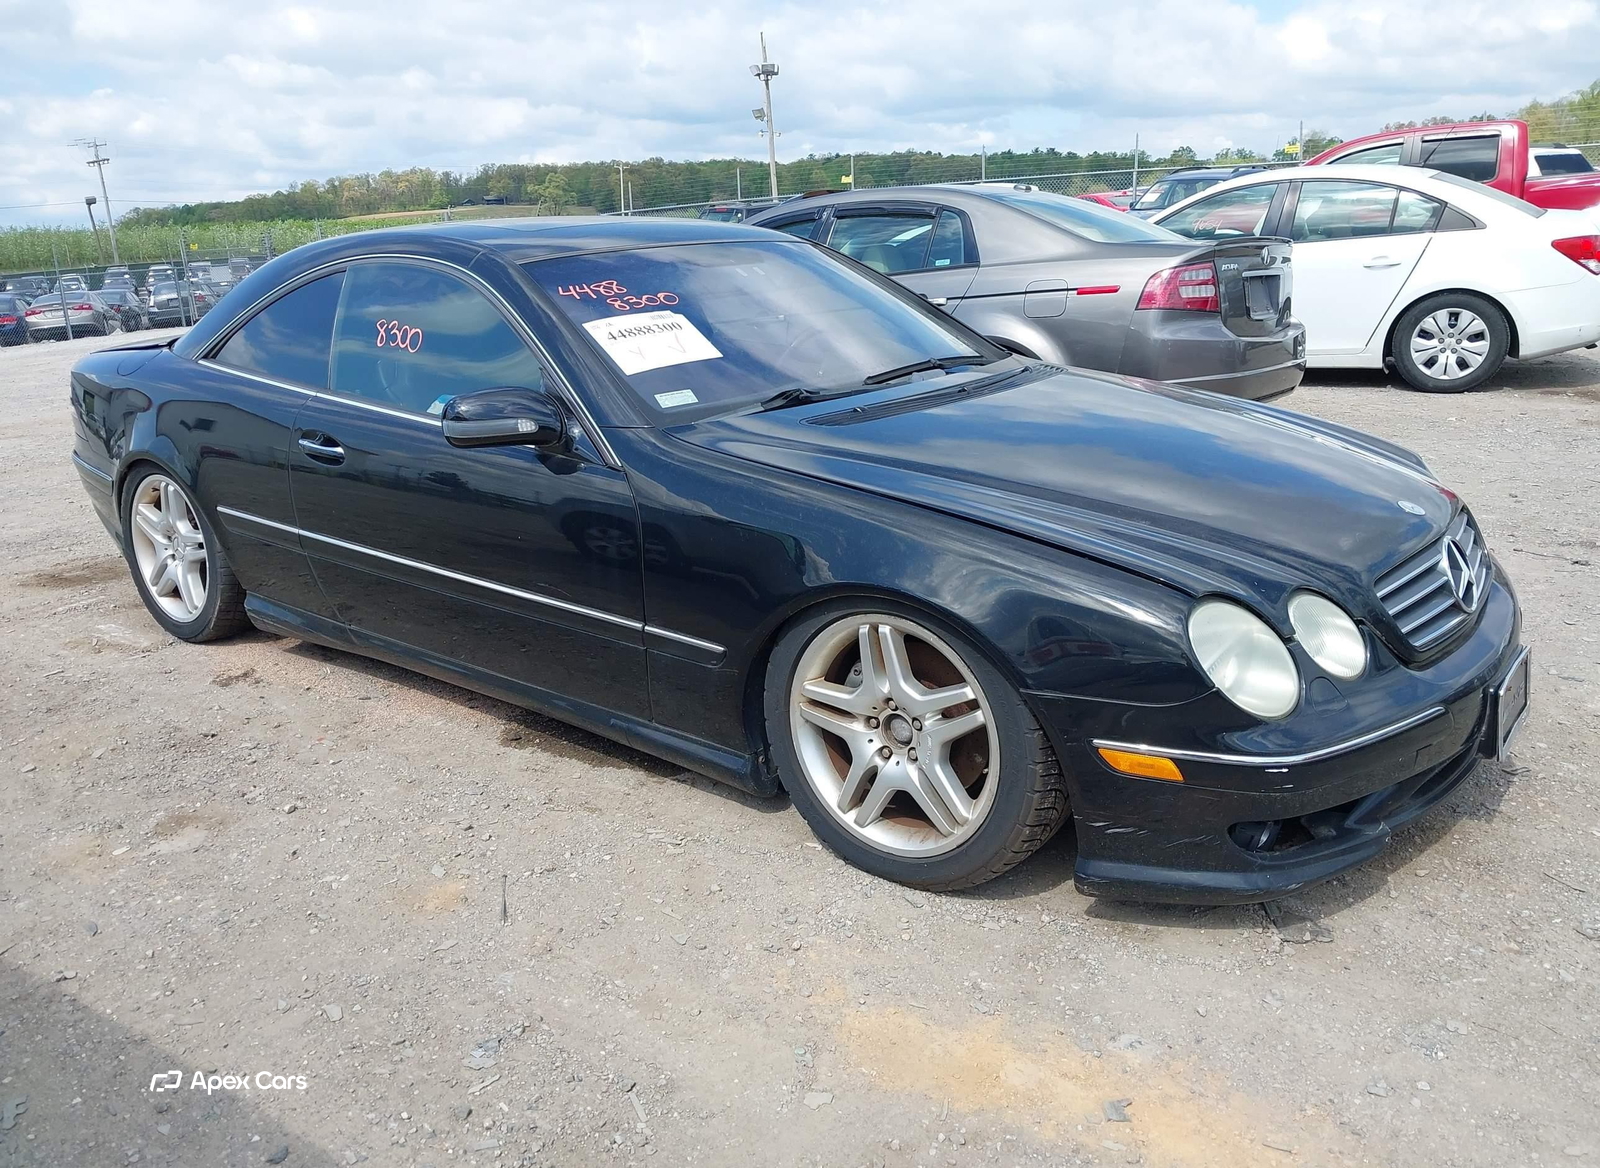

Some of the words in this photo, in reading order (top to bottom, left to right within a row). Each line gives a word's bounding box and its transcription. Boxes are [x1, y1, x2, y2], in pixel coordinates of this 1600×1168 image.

[558, 280, 627, 299] 4488
[607, 292, 679, 311] 8300
[376, 319, 423, 353] 8300
[607, 321, 683, 341] 44888300
